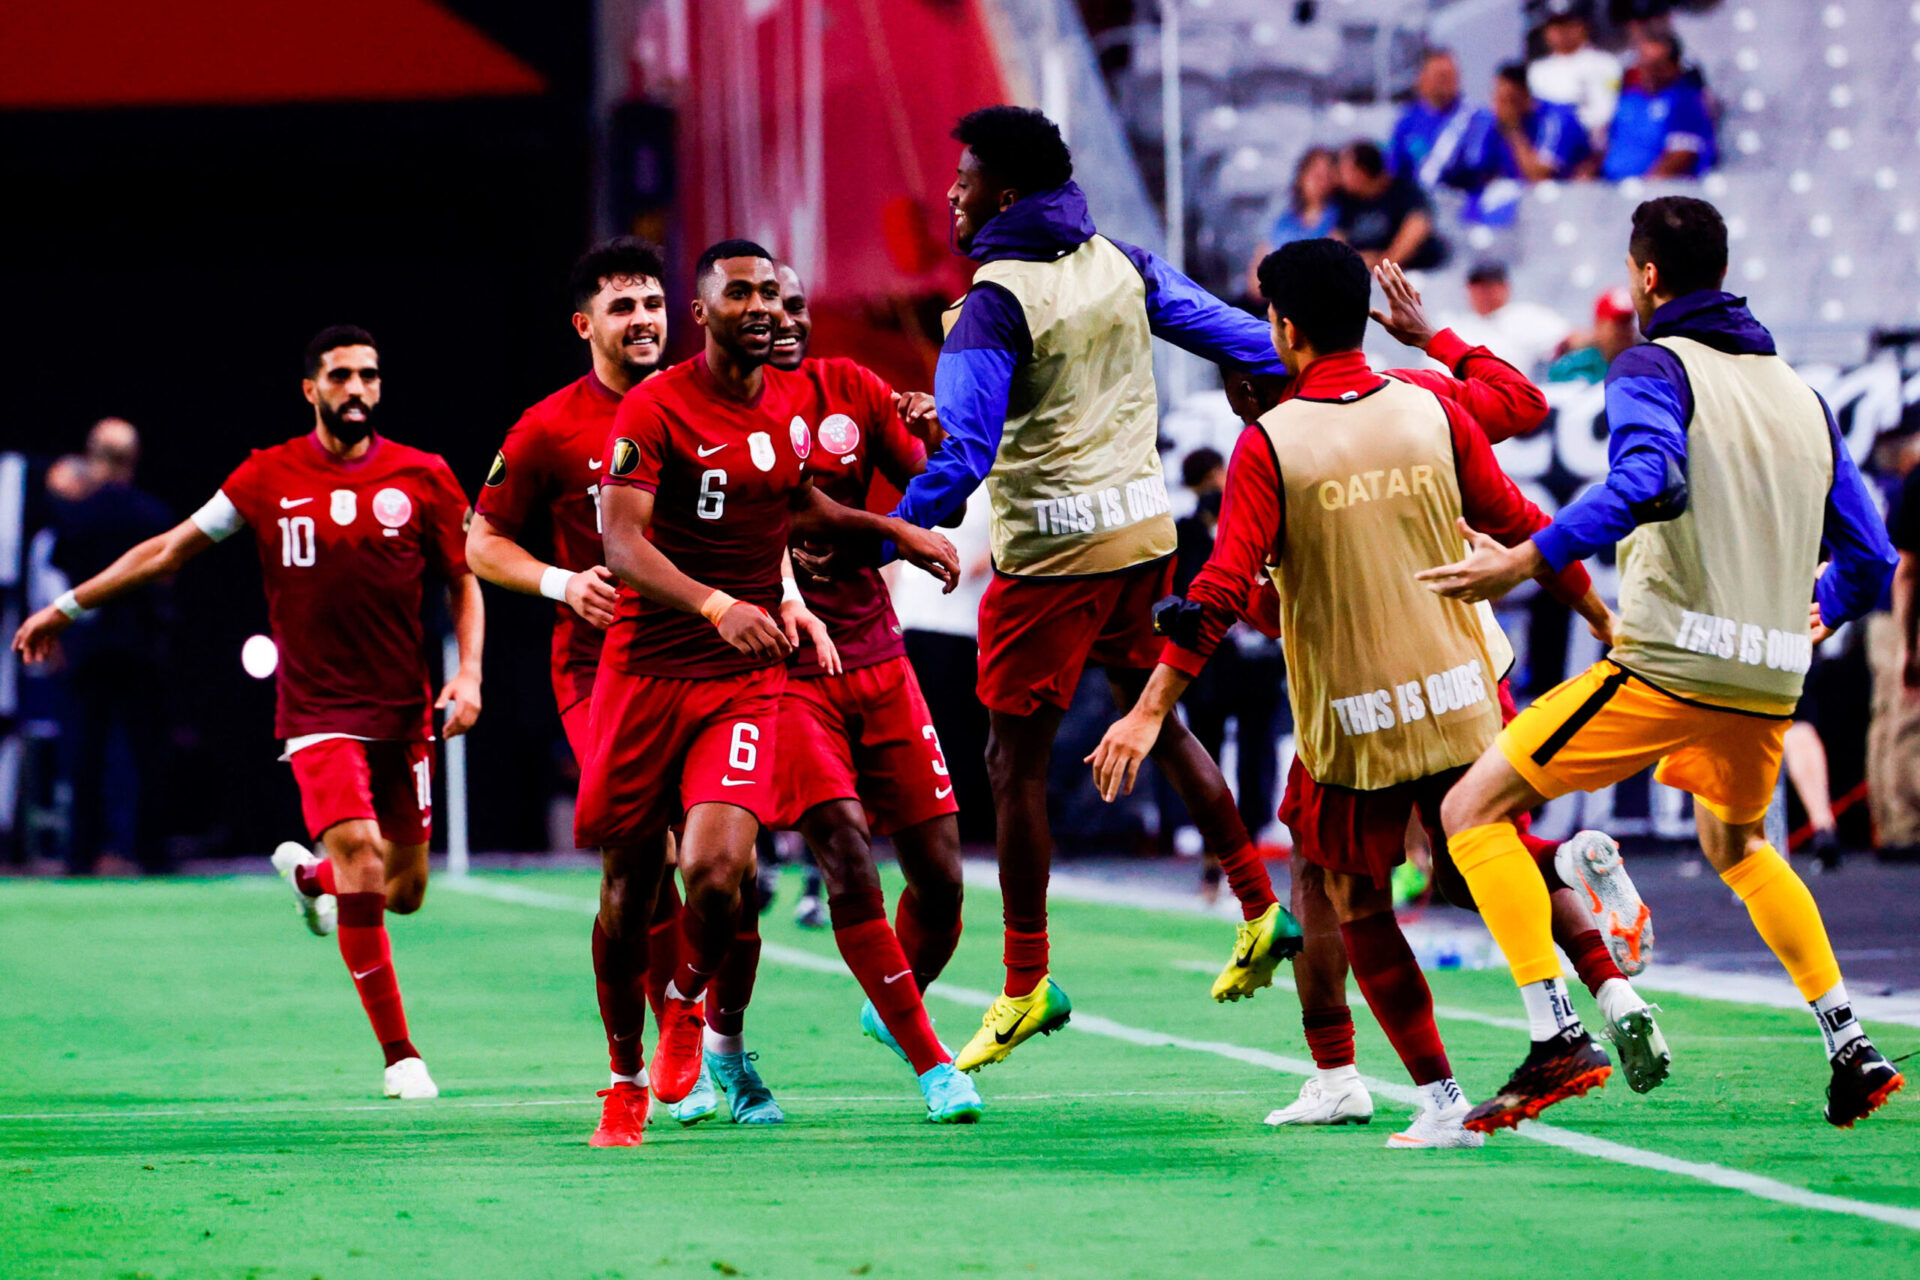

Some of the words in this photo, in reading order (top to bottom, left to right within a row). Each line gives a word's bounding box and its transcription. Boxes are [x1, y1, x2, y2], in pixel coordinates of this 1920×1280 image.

[697, 469, 727, 520] 6
[1033, 493, 1096, 535] THIS
[1097, 487, 1126, 527] IS
[1126, 476, 1170, 521] OUR
[1318, 465, 1433, 511] QATAR
[277, 516, 315, 567] 10
[1674, 610, 1736, 660] THIS
[1738, 622, 1766, 666] IS
[1766, 629, 1811, 675] OUR
[1331, 689, 1395, 736] THIS
[1396, 680, 1426, 724] IS
[1426, 659, 1486, 715] OURS
[729, 722, 759, 771] 6
[922, 725, 949, 775] 3
